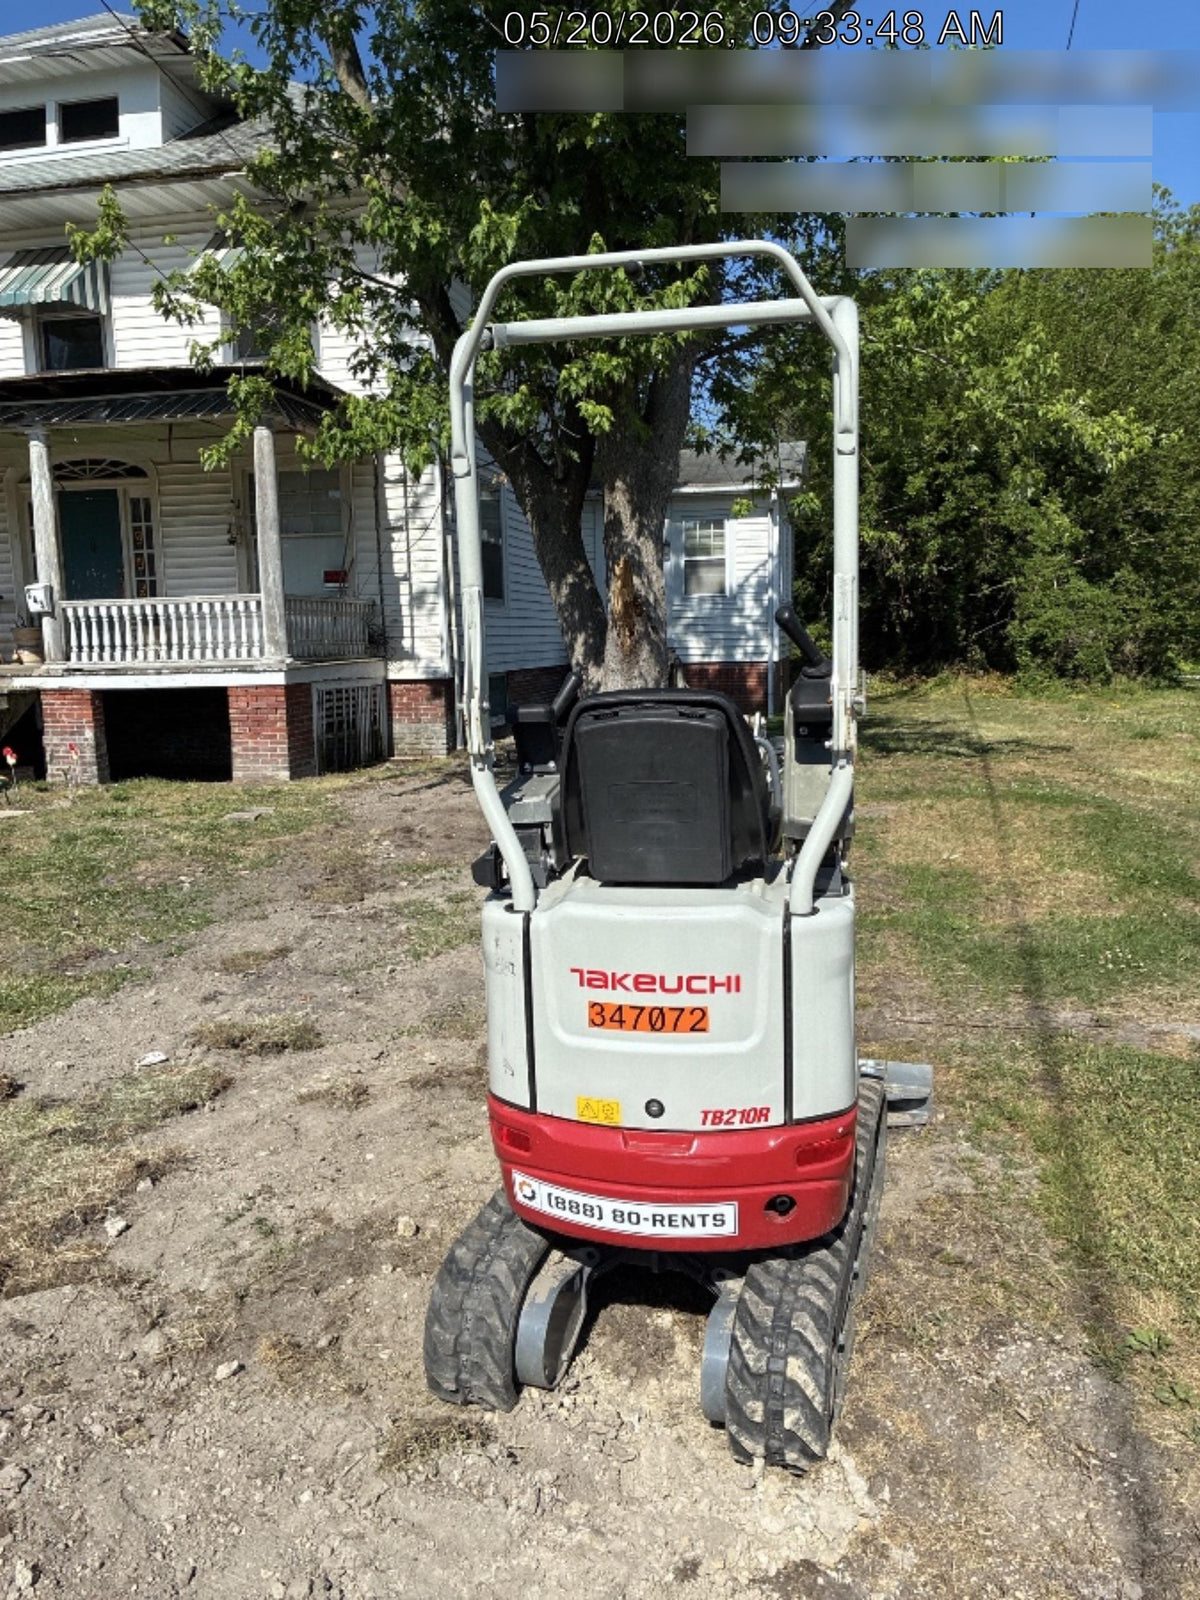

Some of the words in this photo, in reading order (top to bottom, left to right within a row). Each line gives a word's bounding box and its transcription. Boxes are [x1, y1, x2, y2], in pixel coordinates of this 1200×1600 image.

[590, 1002, 707, 1033] 347072
[701, 1107, 770, 1125] TB210R
[547, 1192, 603, 1220] (888)
[612, 1209, 726, 1228] 80-RENTS
